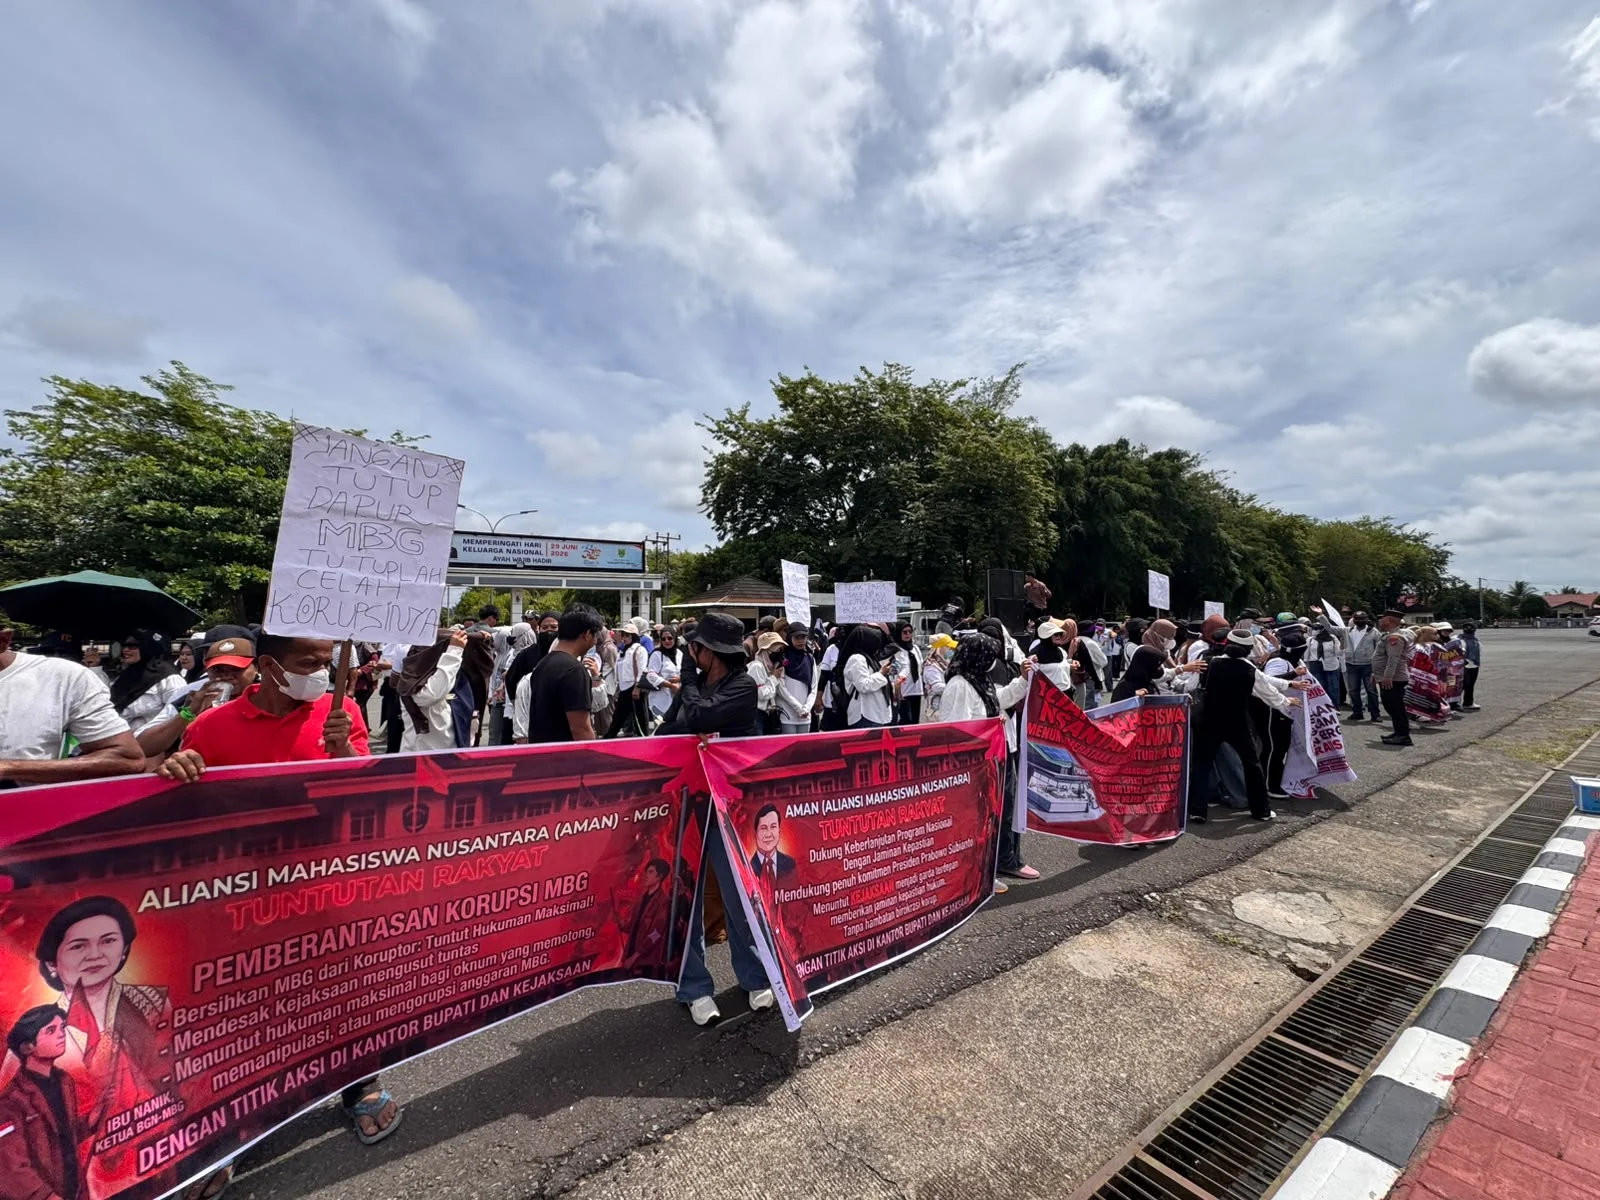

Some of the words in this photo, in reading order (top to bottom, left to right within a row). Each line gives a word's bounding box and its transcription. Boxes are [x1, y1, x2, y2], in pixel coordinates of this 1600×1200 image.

[304, 435, 440, 479] JANGAN
[307, 486, 433, 525] DAPUR
[322, 466, 442, 509] TUTUP
[318, 519, 425, 555] MBG
[462, 538, 522, 547] MEMPERINGATI
[524, 540, 542, 548] HARI
[462, 546, 504, 554] KELUARGA
[506, 548, 544, 556] NASIONAL
[296, 570, 401, 599] CELAH
[269, 590, 439, 637] KORUPSINYA
[785, 802, 819, 818] AMAN
[821, 797, 864, 816] (ALIANSI
[865, 786, 921, 805] MAHASISWA
[921, 772, 971, 795] NUSANTARA)
[809, 846, 843, 863] Dukung
[843, 832, 895, 855] Keberlanjutan
[897, 826, 925, 843] Program
[925, 816, 953, 833] Nasional
[819, 808, 896, 841] TUNTUTAN
[898, 796, 946, 823] RAKYAT
[137, 870, 258, 913] ALIANSI
[267, 846, 421, 887] MAHASISWA
[426, 826, 549, 860] NUSANTARA
[554, 813, 619, 841] (AMAN)
[634, 803, 669, 823] MBG
[774, 878, 831, 904] Mendukung
[832, 874, 857, 893] penuh
[857, 865, 892, 882] komitmen
[892, 857, 920, 873] Presiden
[920, 849, 947, 865] Prabowo
[948, 838, 974, 855] Subianto
[843, 855, 871, 872] Dengan
[872, 847, 902, 862] Jaminan
[902, 836, 934, 855] Kepastian
[225, 869, 425, 930] TUNTUTAN
[433, 845, 549, 887] RAKYAT
[813, 897, 850, 915] Menuntut
[851, 880, 895, 905] KEJAKSAAN
[895, 873, 918, 890] menjadi
[919, 869, 936, 884] garda
[830, 907, 873, 926] memberikan
[873, 897, 898, 916] jaminan
[898, 886, 926, 904] kepastian
[193, 905, 439, 993] PEMBERANTASAN
[445, 882, 539, 924] KORUPSI
[544, 871, 589, 900] MBG
[824, 948, 847, 966] TITIK
[848, 940, 866, 959] AKSI
[867, 938, 875, 951] DI
[876, 927, 904, 947] KANTOR
[905, 916, 927, 935] BUPATI
[927, 910, 941, 924] DAN
[843, 923, 864, 938] Tanpa
[865, 913, 896, 931] hambatan
[895, 902, 920, 922] birokrasi
[173, 986, 269, 1029] Bersihkan
[275, 968, 313, 996] MBG
[318, 957, 349, 981] dari
[353, 941, 422, 971] Koruptor:
[425, 928, 474, 949] Tuntut
[472, 914, 532, 937] Hukuman
[535, 896, 594, 921] Maksimal!
[174, 1006, 270, 1055] Mendesak
[275, 978, 358, 1017] Kejaksaan
[363, 953, 434, 986] mengusut
[438, 943, 479, 963] tuntas
[175, 1030, 261, 1083] Menuntut
[266, 1004, 341, 1042] hukuman
[346, 978, 417, 1012] maksimal
[421, 967, 450, 988] bagi
[454, 954, 497, 977] oknum
[501, 944, 530, 964] yang
[533, 926, 595, 953] memotong,
[212, 1025, 334, 1092] memanipulasi,
[338, 1012, 371, 1035] atau
[375, 981, 456, 1021] mengorupsi
[460, 964, 521, 993] anggaran
[521, 953, 550, 972] MBG.
[138, 1106, 227, 1175] DENGAN
[231, 1079, 279, 1120] TITIK
[283, 1057, 325, 1095] AKSI
[331, 1048, 347, 1070] DI
[352, 1020, 419, 1060] KANTOR
[423, 999, 476, 1031] BUPATI
[480, 986, 510, 1010] DAN
[513, 960, 592, 997] KEJAKSAAN
[94, 1128, 133, 1154] KETUA
[136, 1100, 185, 1134] BGN-MBG
[106, 1113, 131, 1133] IBU
